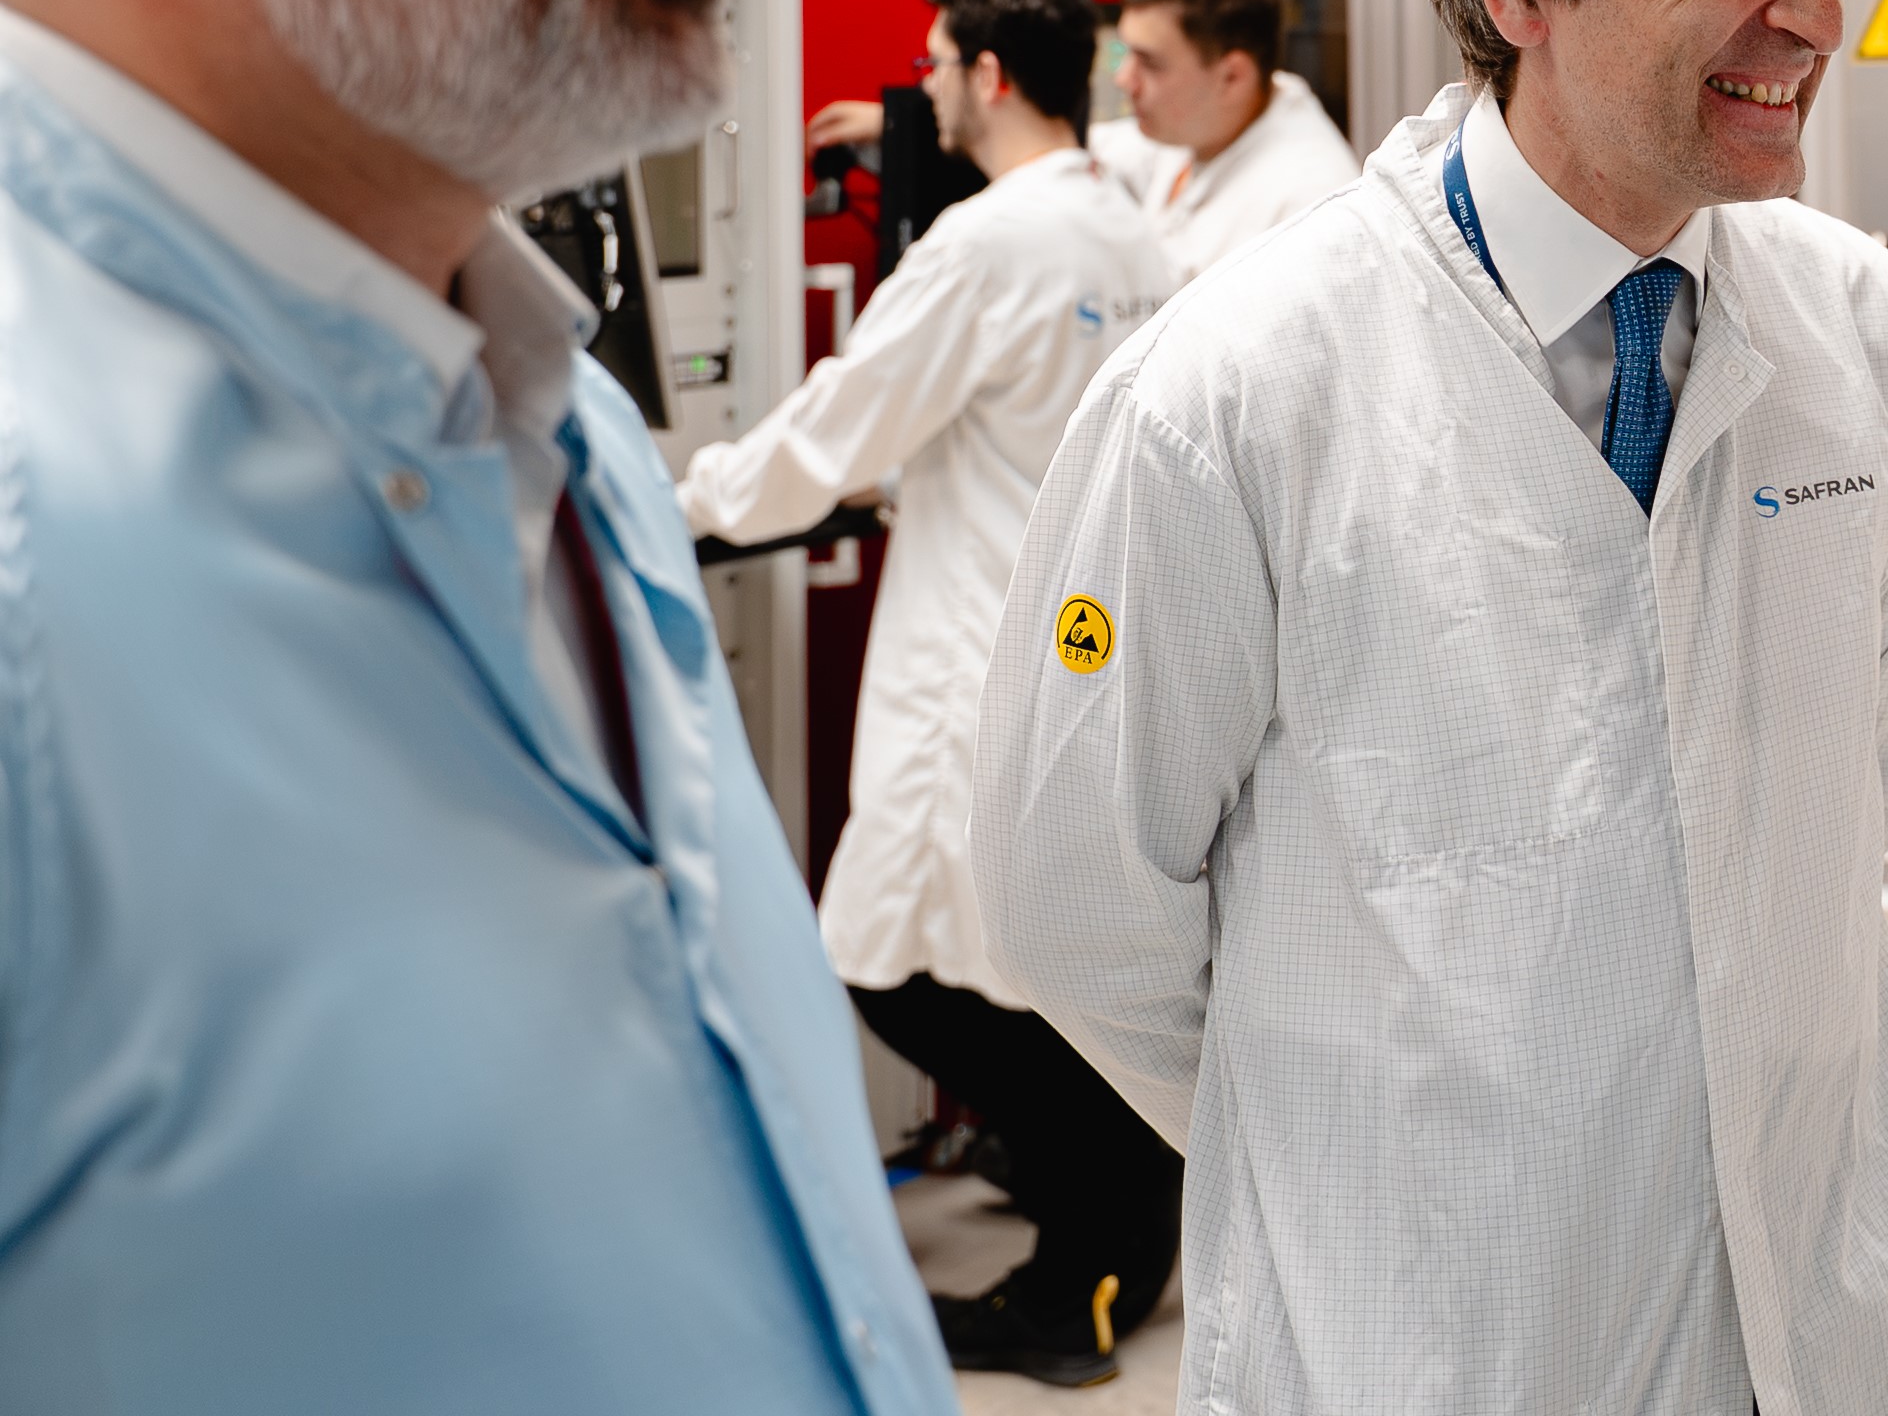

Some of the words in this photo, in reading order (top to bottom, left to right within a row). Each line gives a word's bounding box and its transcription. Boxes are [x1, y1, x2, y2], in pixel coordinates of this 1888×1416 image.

[1454, 192, 1471, 225] TRUST
[1464, 226, 1477, 240] BY
[1784, 474, 1875, 505] SAFRAN
[1065, 646, 1093, 665] EPA
